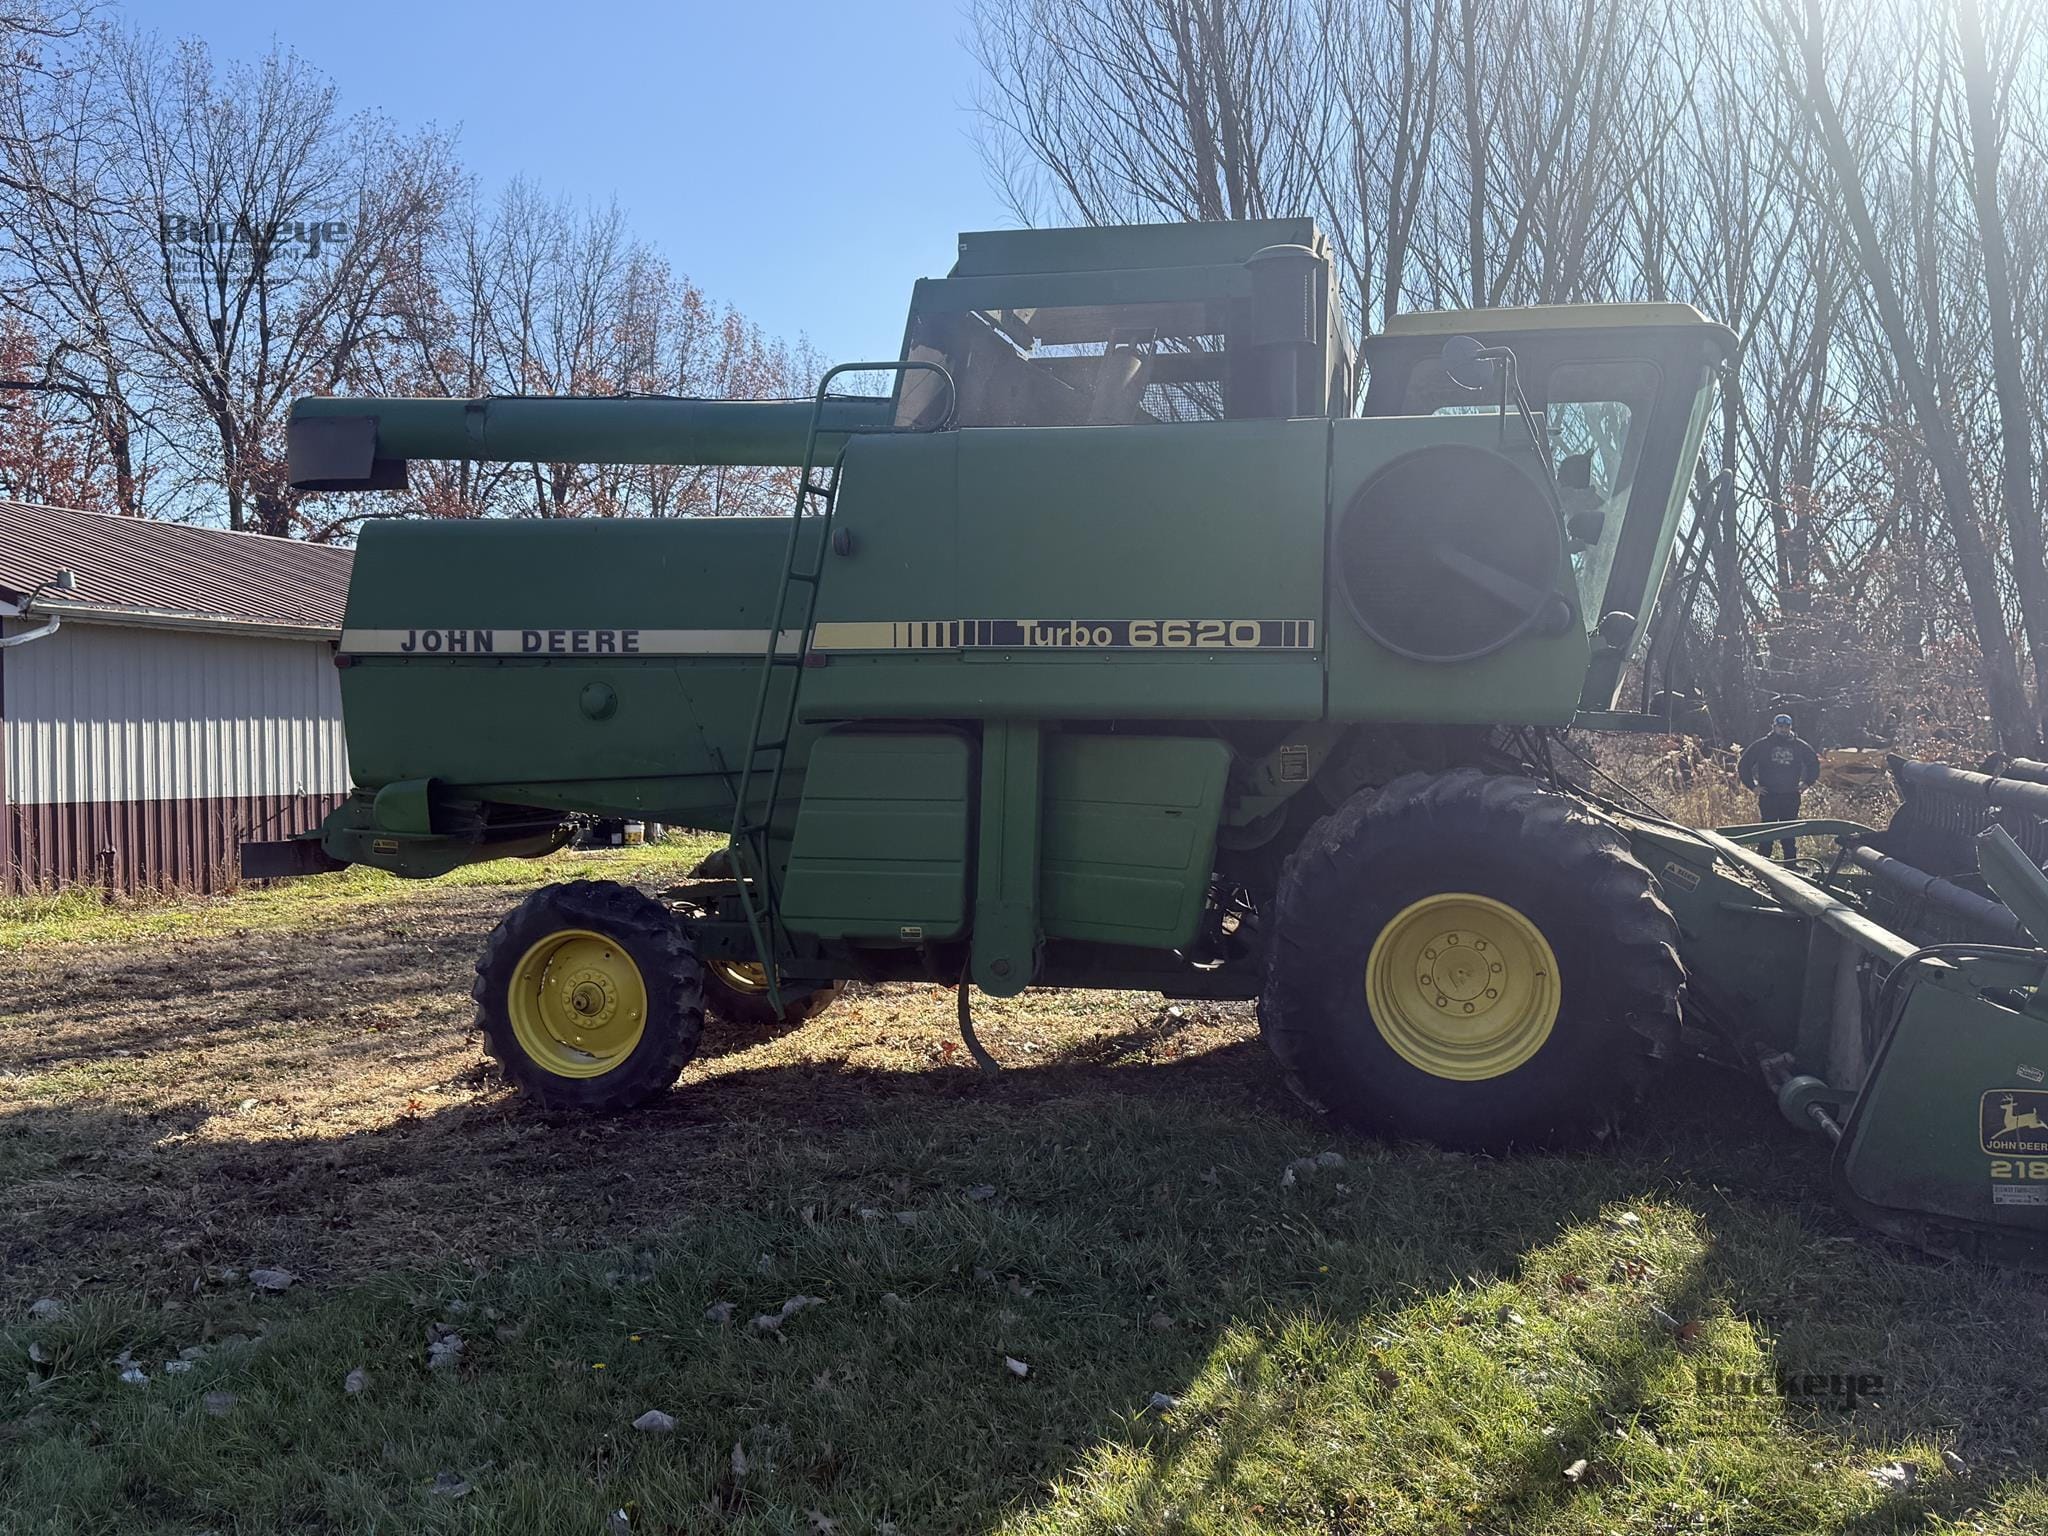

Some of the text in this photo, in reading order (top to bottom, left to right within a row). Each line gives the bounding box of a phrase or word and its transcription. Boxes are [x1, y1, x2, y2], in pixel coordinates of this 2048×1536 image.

[401, 629, 641, 653] JOHN DEERE
[1016, 619, 1262, 648] Turbo 6620
[1986, 1140, 2017, 1150] JOHN
[1991, 1160, 2048, 1179] 218
